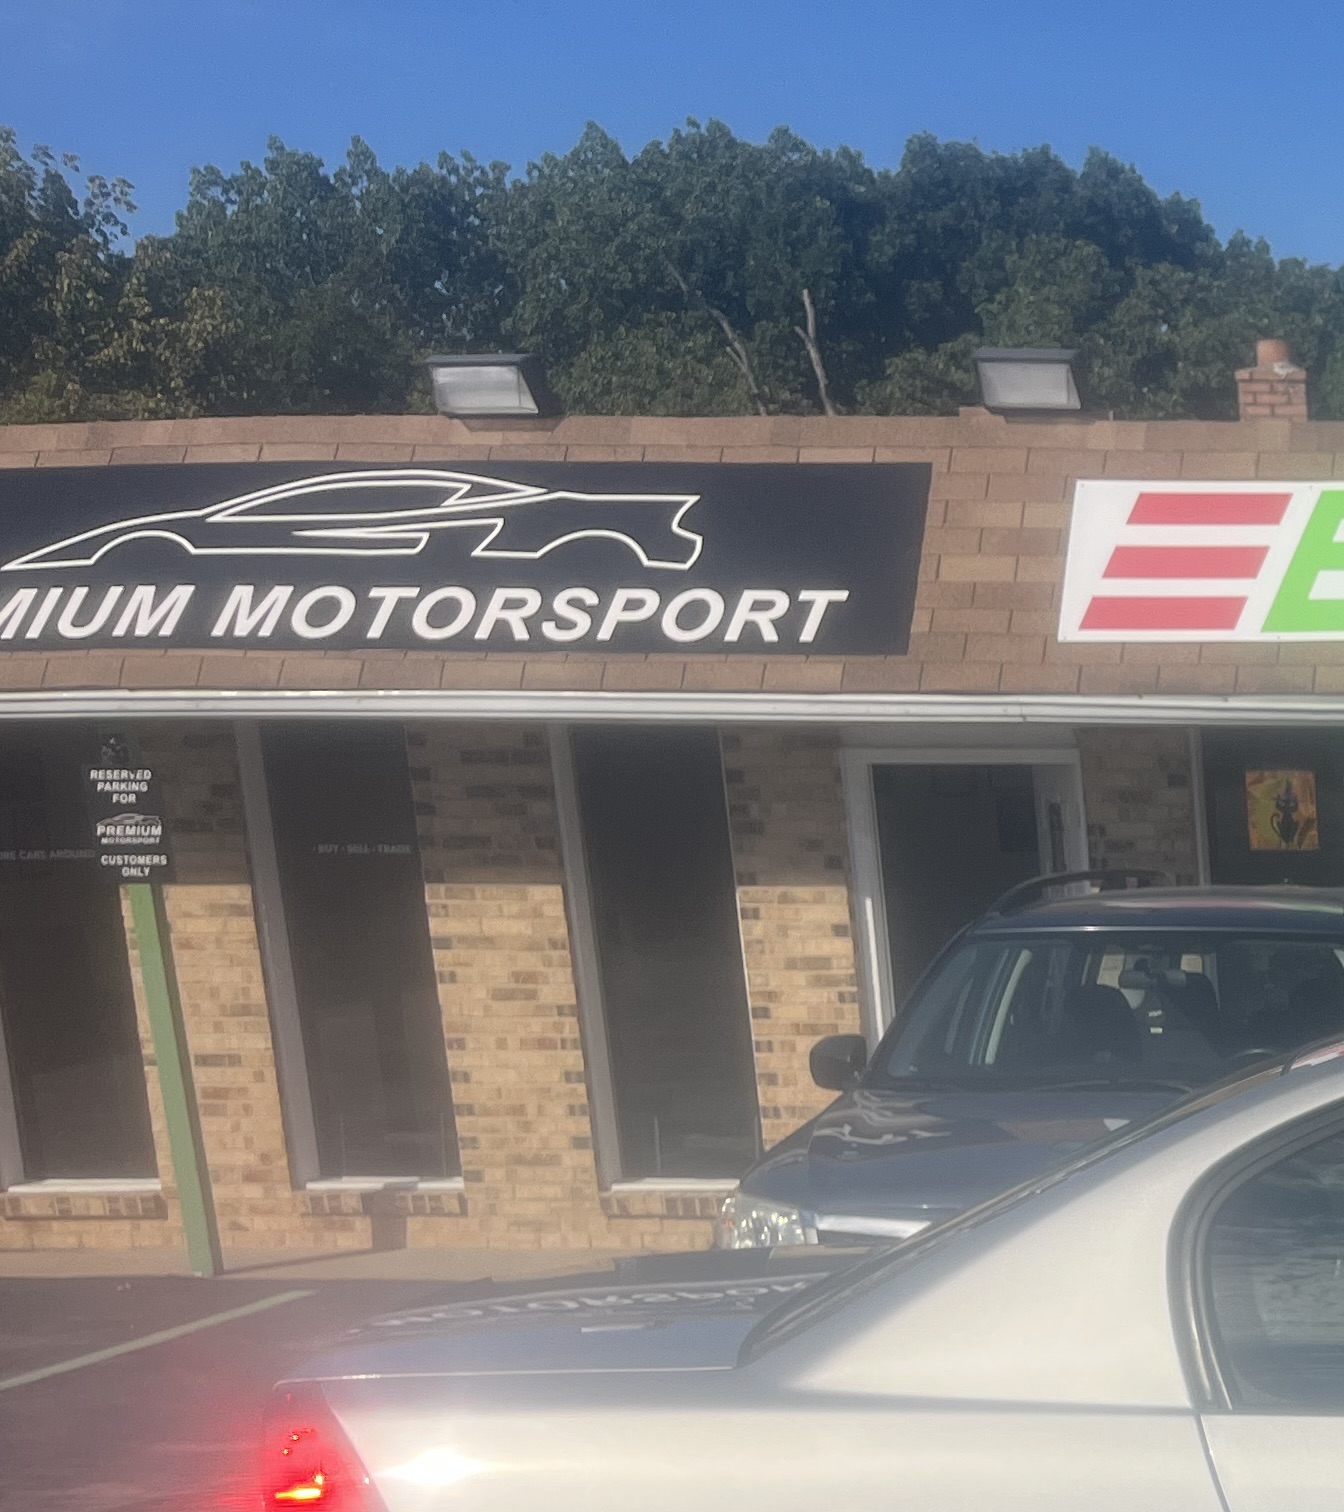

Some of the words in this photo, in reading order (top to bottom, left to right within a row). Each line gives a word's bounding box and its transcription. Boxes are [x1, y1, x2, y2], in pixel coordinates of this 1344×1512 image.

[211, 585, 850, 643] MOTORSPORT
[90, 769, 152, 780] RESERVED
[97, 781, 148, 792] PARKING
[112, 793, 136, 804] FOR
[96, 825, 162, 837] PREMIUM
[101, 854, 168, 866] CUSTOMERS
[121, 866, 151, 877] ONLY
